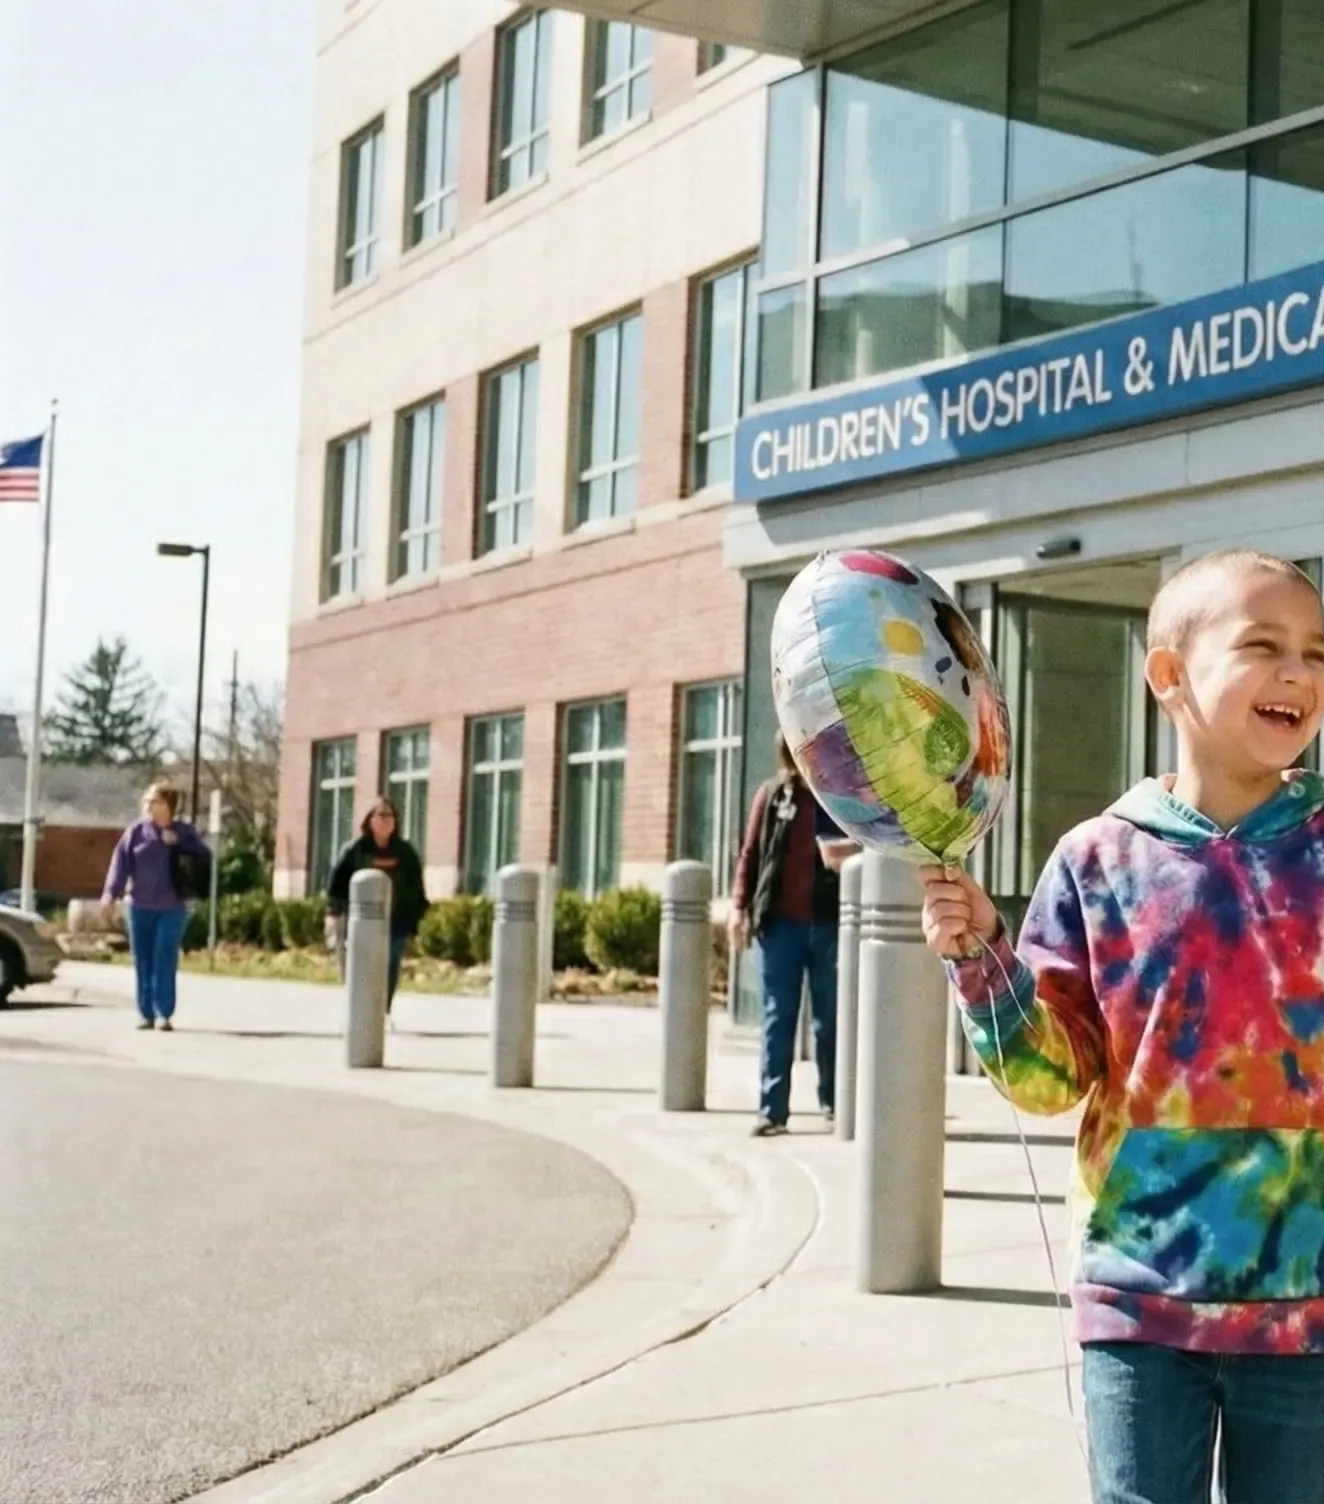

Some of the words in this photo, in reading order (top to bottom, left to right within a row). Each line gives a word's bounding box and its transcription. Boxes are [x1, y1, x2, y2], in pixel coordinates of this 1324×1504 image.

[751, 395, 931, 480] CHILDREN'S
[941, 348, 1112, 437] HOSPITAL
[1124, 337, 1155, 396] &
